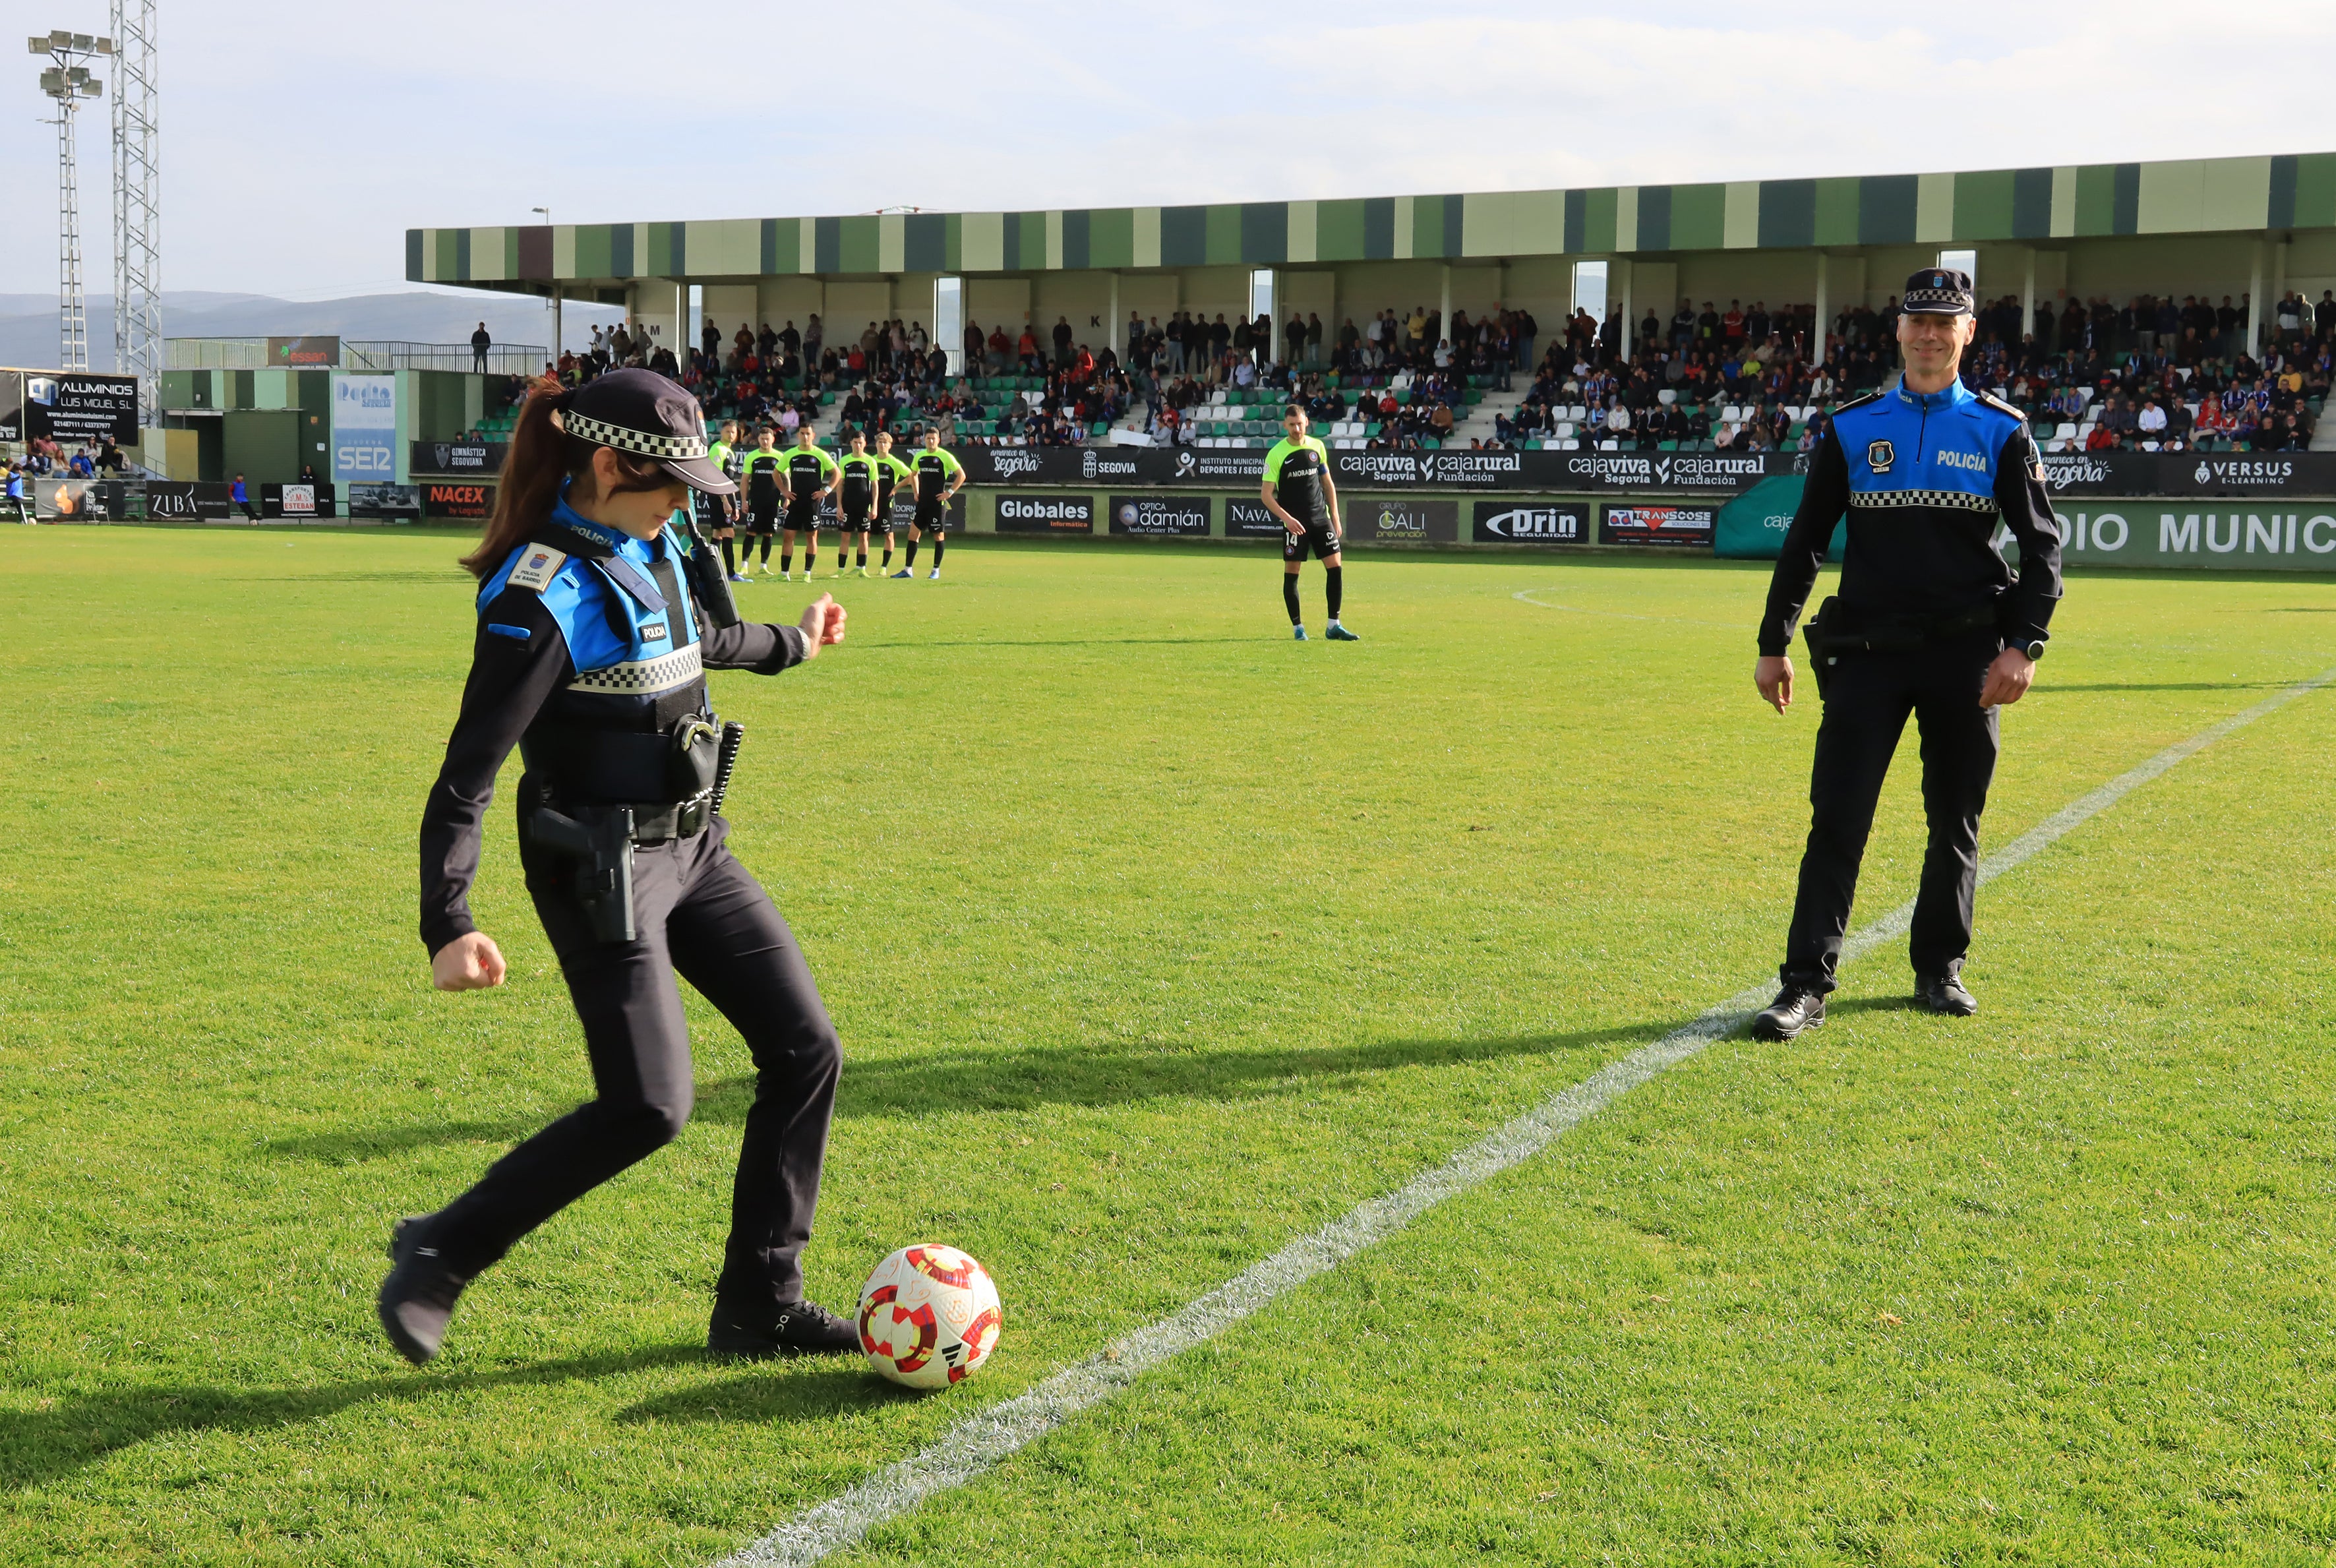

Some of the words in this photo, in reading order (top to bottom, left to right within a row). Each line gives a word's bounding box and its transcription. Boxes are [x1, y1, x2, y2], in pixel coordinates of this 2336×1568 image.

[1091, 315, 1100, 327] K
[650, 325, 660, 336] M
[61, 382, 133, 396] ALUMINIOS
[61, 397, 80, 407] LUIS
[84, 398, 115, 409] MIGUEL
[452, 446, 486, 456] GIMNÁSTICA
[338, 446, 391, 471] SER
[452, 457, 483, 466] SEGOVIANA
[1340, 453, 1416, 475] cajaviva
[1437, 452, 1520, 475] cajarural
[1937, 450, 1987, 473] POLICÍA
[2041, 456, 2076, 464] manece
[994, 455, 1038, 478] segovia
[1098, 462, 1137, 473] SEGOVIA
[1200, 466, 1237, 474] DEPORTES
[1569, 454, 1650, 478] cajaviva
[1673, 454, 1765, 478] cajarural
[2213, 461, 2292, 476] VERSUS
[1373, 471, 1416, 482] Segovia
[1437, 471, 1495, 482] Fundación
[1605, 474, 1650, 485] Segovia
[1673, 474, 1737, 485] Fundación
[431, 486, 485, 502] NACEX
[153, 484, 197, 517] ZIBÁ
[1139, 502, 1166, 511] OPTICA
[1379, 502, 1406, 511] GRUPO
[448, 506, 456, 515] by
[459, 506, 485, 516] Logista
[1001, 500, 1088, 519] Globales
[1634, 510, 1711, 520] TRANSCOSE
[1139, 509, 1204, 527] damián
[1379, 512, 1425, 530] GALI
[1512, 508, 1577, 533] Drin
[1286, 531, 1298, 547] 14
[1376, 529, 1427, 539] prevención
